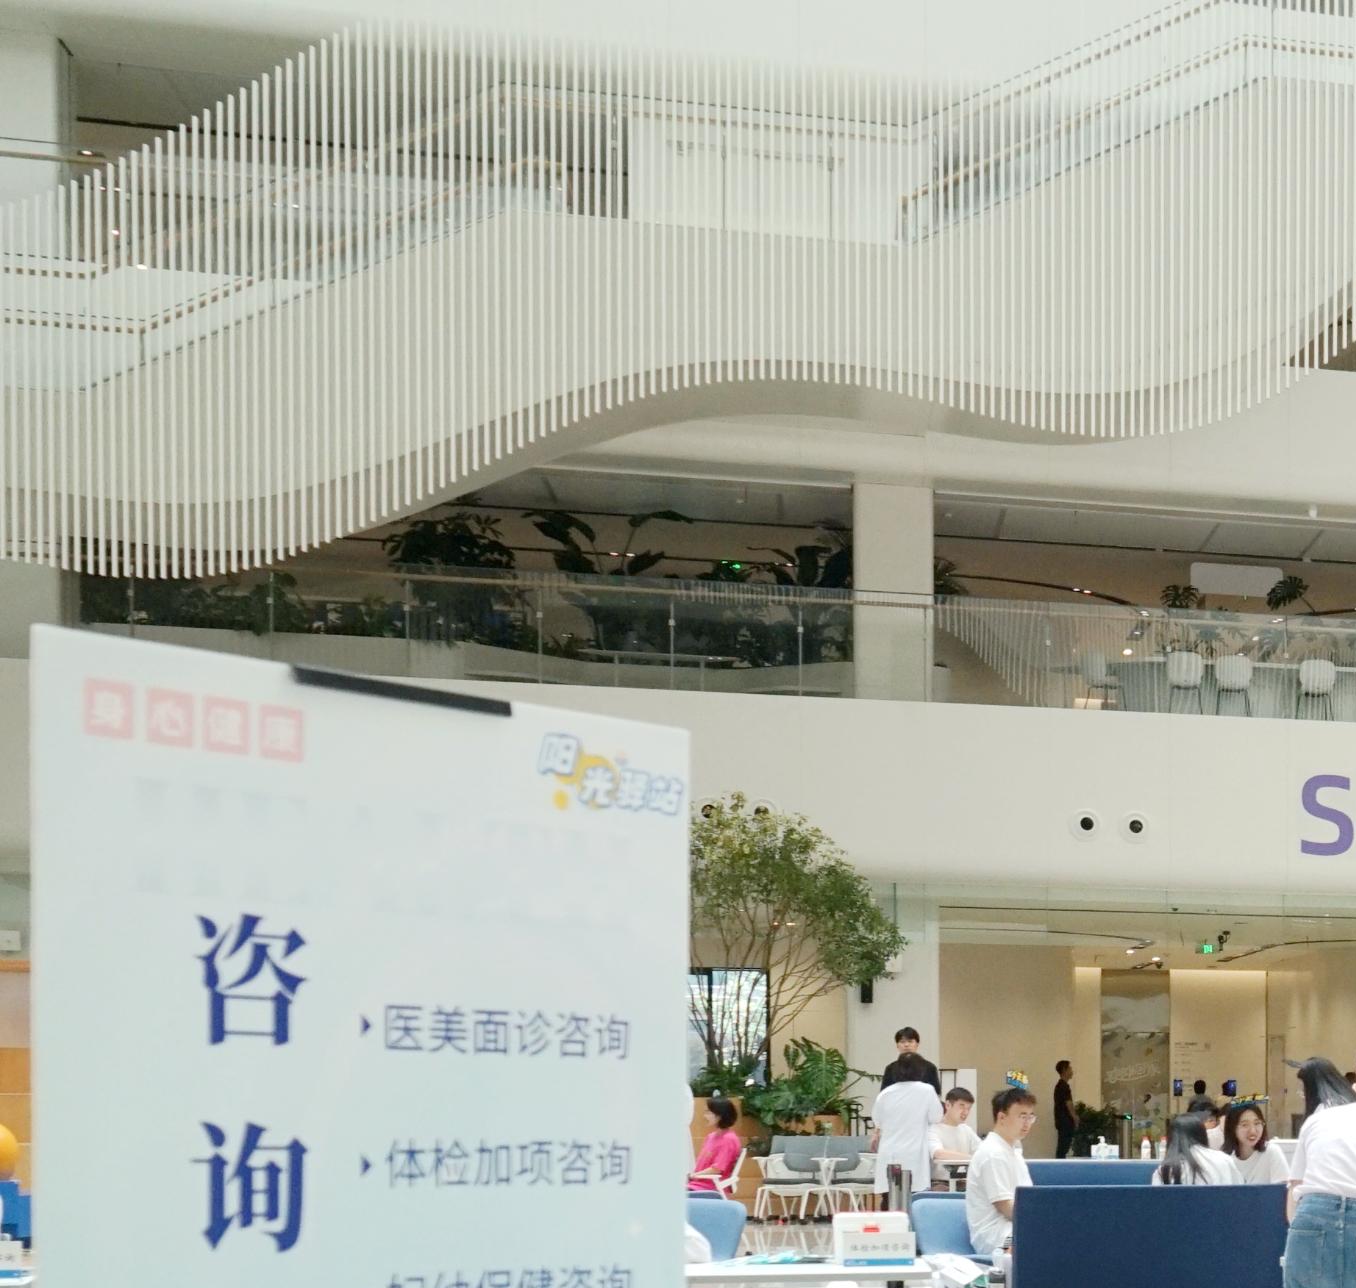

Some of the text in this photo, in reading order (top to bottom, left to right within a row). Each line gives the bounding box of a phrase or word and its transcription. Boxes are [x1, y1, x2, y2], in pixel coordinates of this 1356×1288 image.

[90, 689, 298, 752] 身心健康
[538, 732, 684, 815] 阳光驿站
[1301, 775, 1355, 856] S
[384, 1003, 630, 1060] 医美面诊咨询
[384, 1138, 632, 1190] 体检加项咨询
